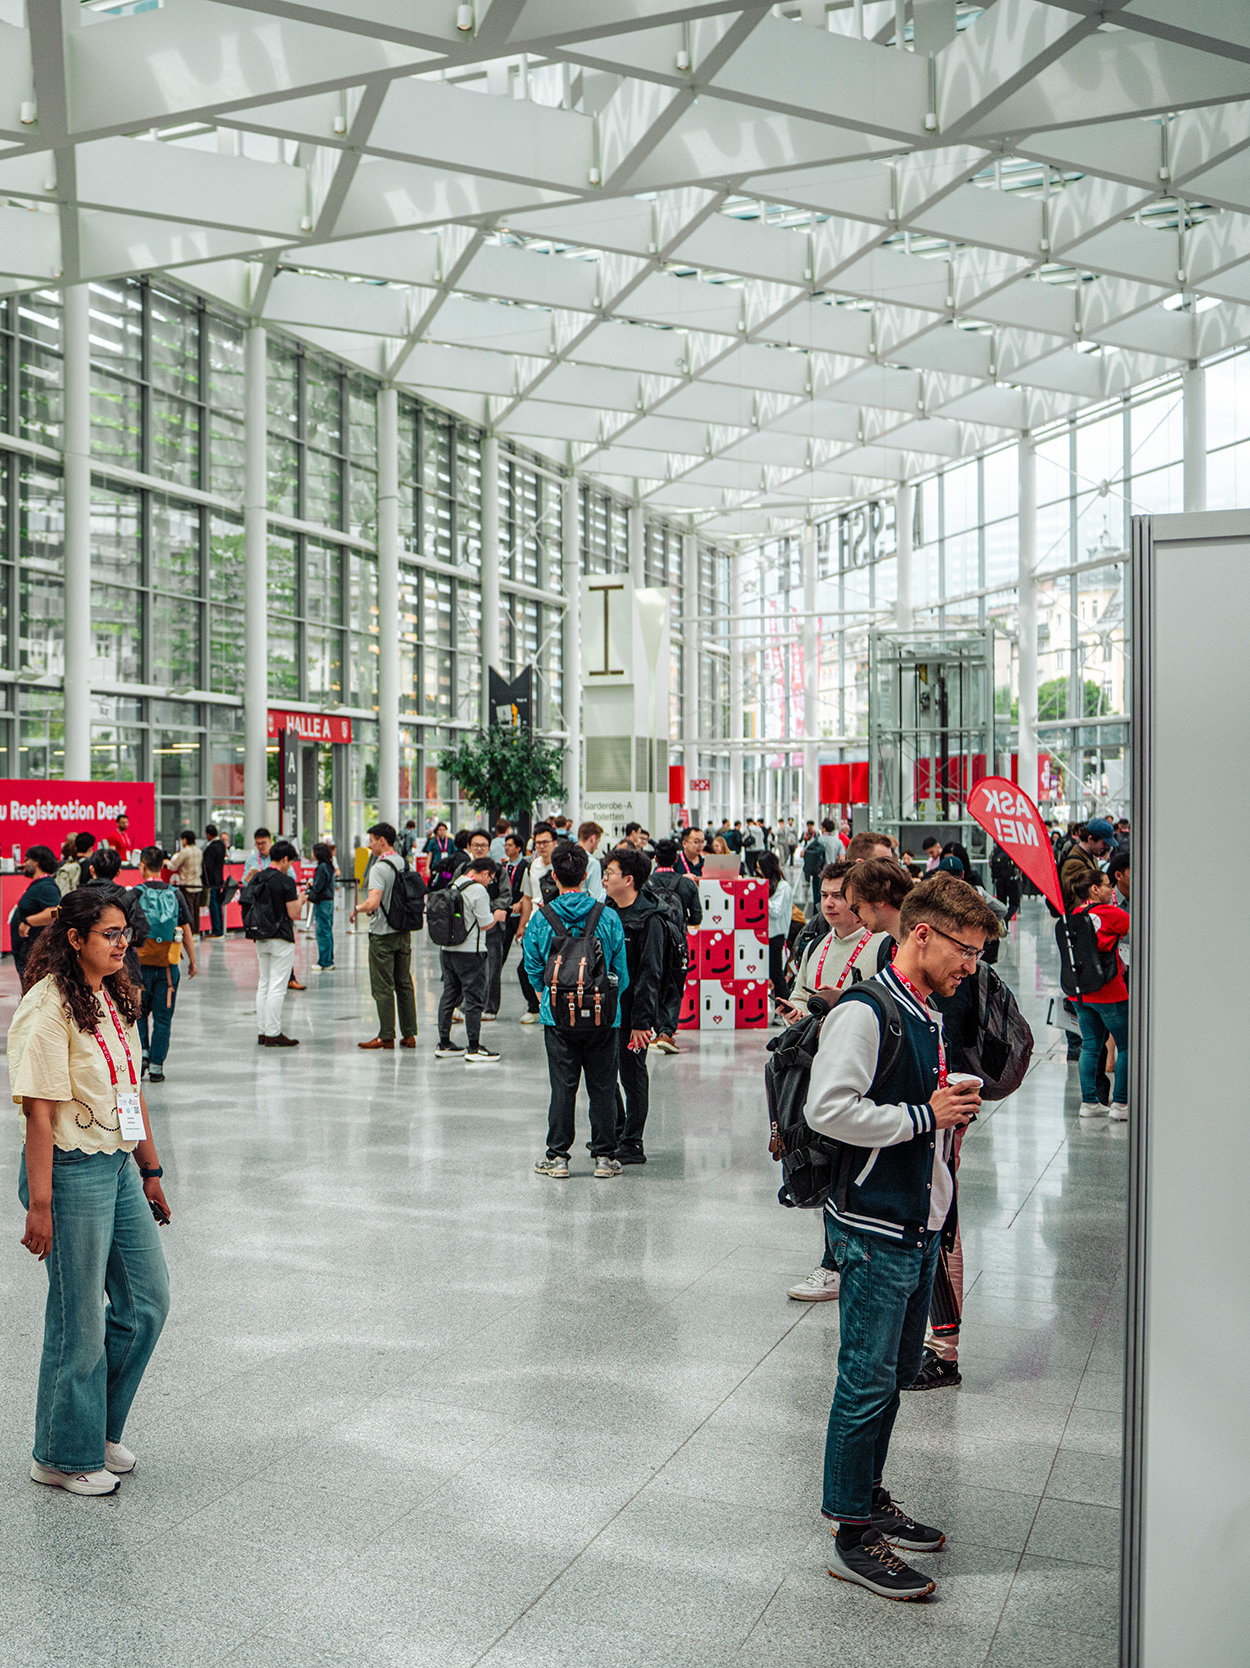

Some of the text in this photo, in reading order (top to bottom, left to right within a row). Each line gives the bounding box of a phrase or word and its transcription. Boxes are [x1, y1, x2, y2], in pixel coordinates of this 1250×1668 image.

[286, 715, 331, 738] HALLE A
[10, 799, 95, 826] Registration
[97, 799, 128, 821] Desk
[593, 812, 625, 821] Toiletten
